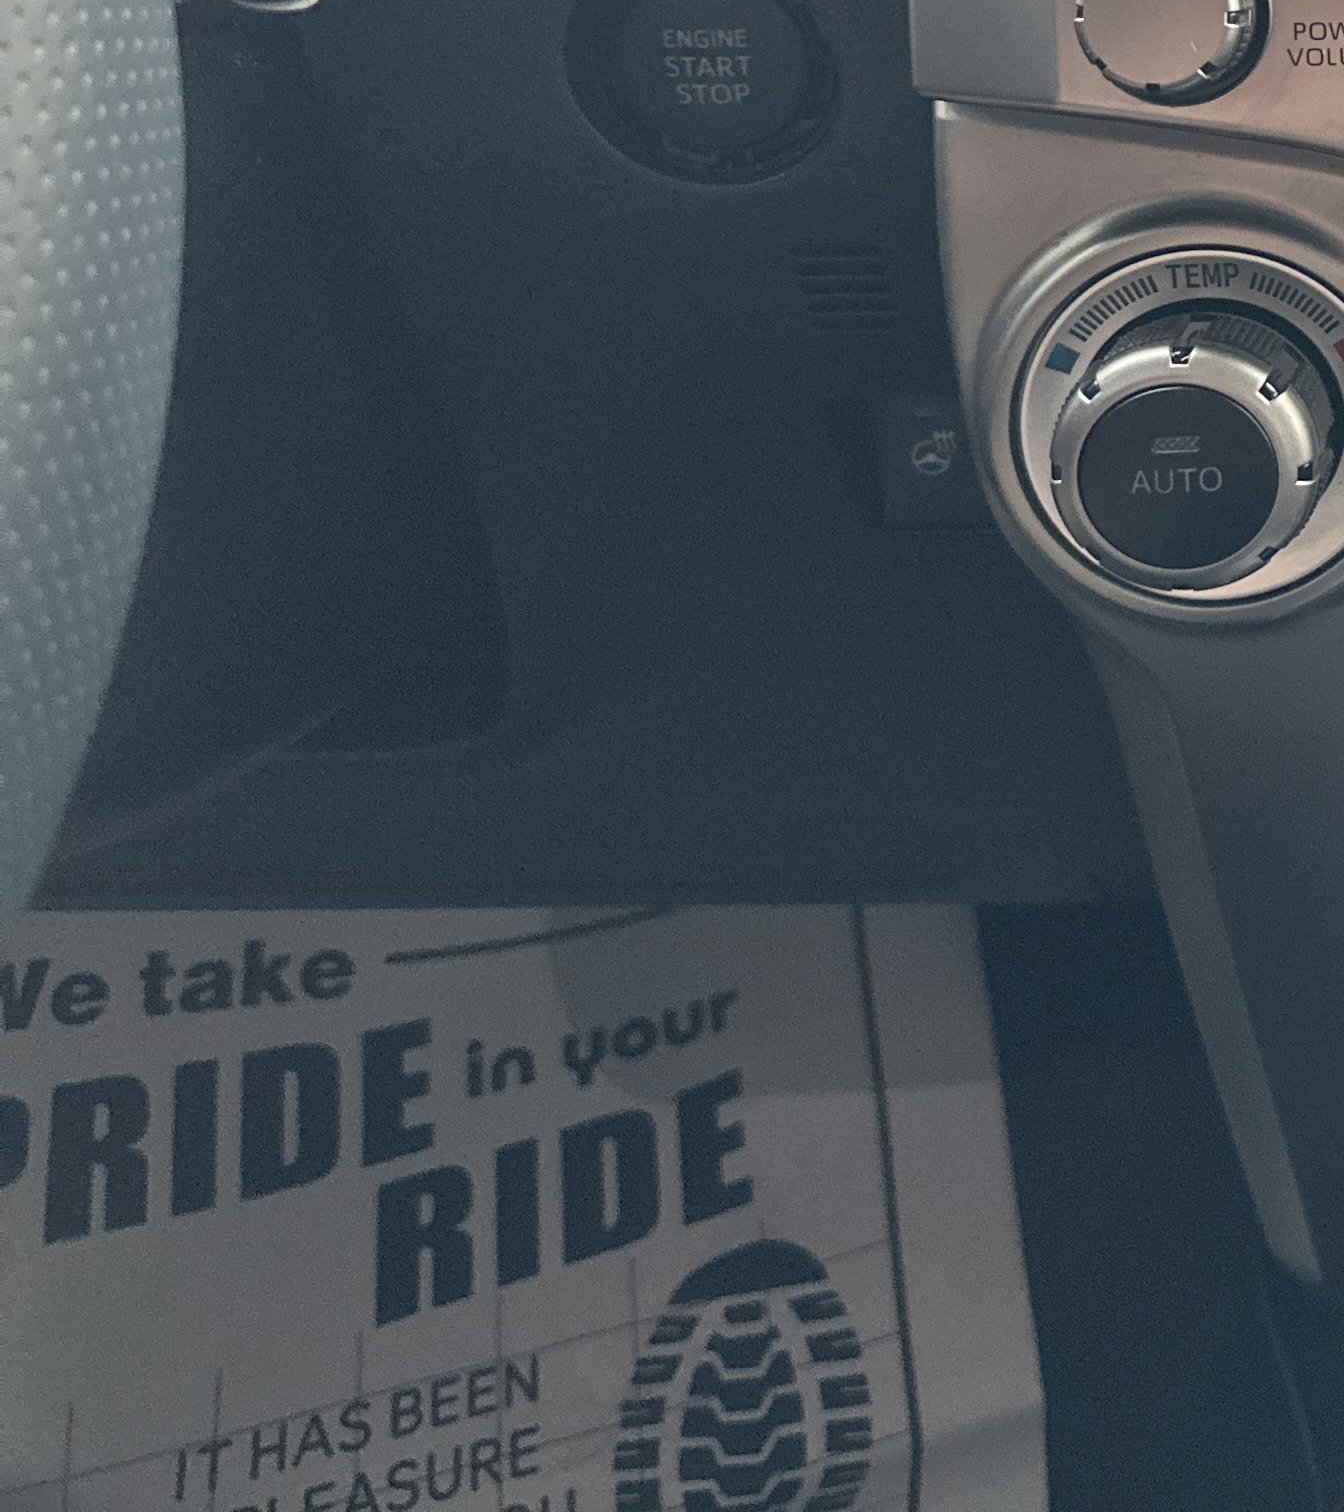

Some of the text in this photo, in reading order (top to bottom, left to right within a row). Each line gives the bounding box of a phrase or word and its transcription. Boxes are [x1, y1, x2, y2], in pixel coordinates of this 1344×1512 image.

[663, 28, 748, 49] ENGINE
[664, 55, 752, 78] START
[676, 83, 751, 104] STOP
[1165, 263, 1240, 290] TEMP
[1131, 466, 1223, 495] AUTO
[139, 938, 357, 1017] take
[464, 1038, 537, 1099] in
[562, 988, 742, 1088] your
[374, 1068, 757, 1330] RIDE
[173, 1351, 541, 1503] IT HAS BEEN
